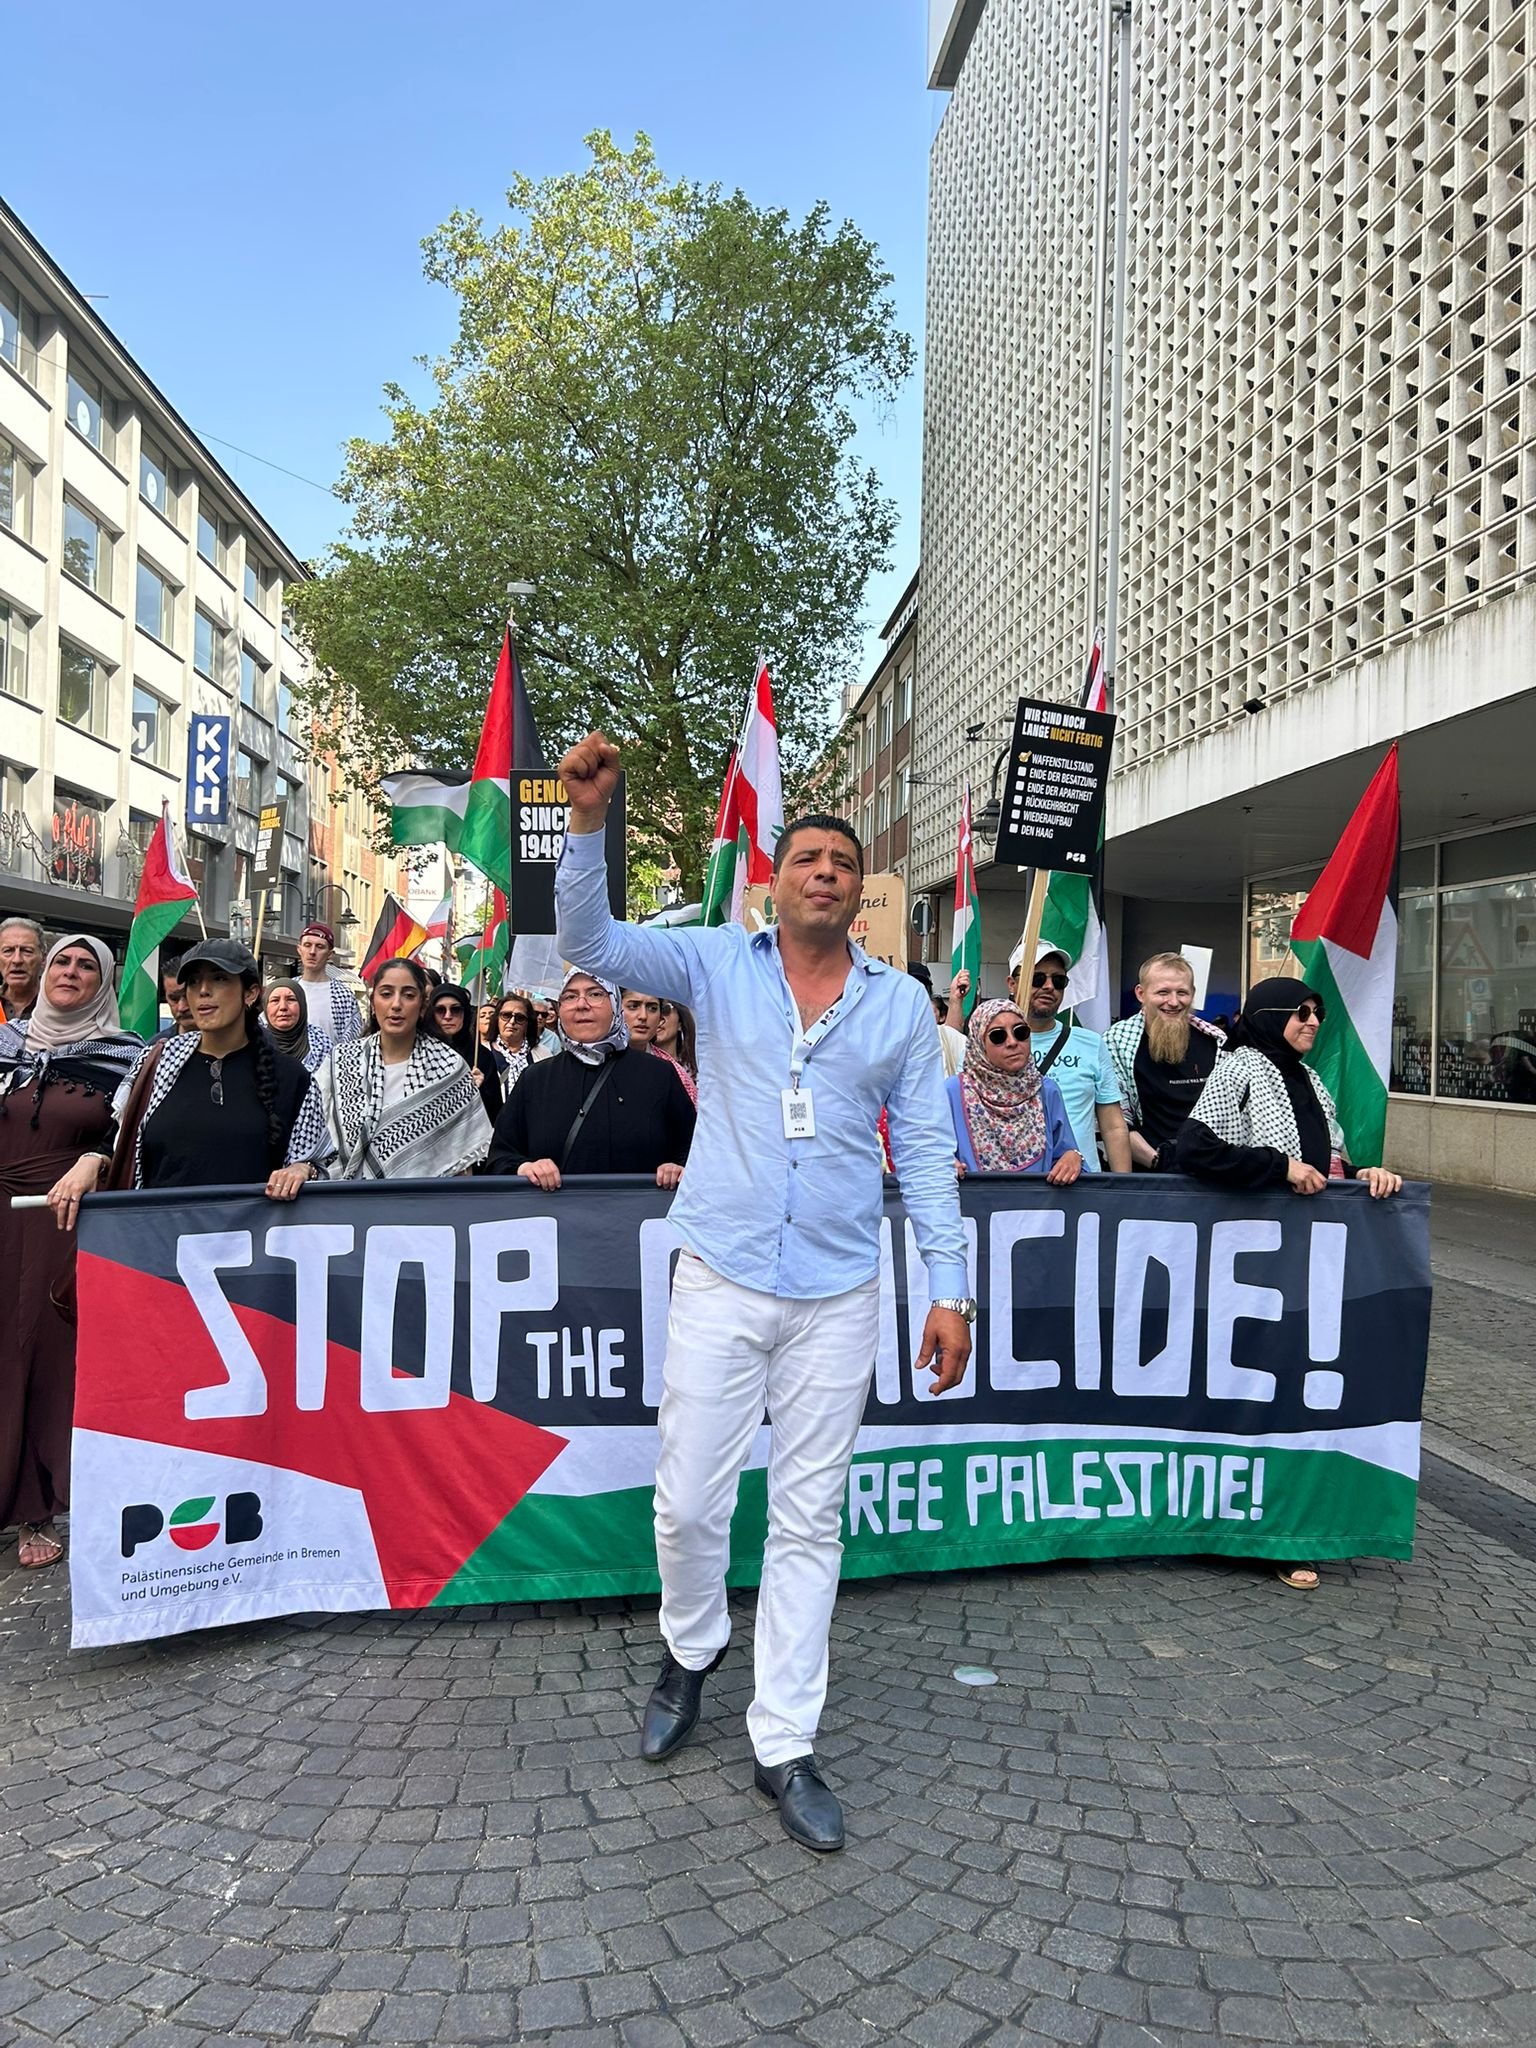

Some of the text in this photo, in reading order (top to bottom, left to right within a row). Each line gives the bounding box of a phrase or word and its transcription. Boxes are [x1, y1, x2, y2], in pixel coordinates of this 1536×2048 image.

[1024, 707, 1086, 730] WIR SIND NOCH
[1021, 722, 1103, 748] LANGE NICHT FERTIG
[194, 722, 222, 815] KKH
[1032, 753, 1094, 773] WAFFENSTILLSTAND
[1027, 782, 1045, 794] ENDE
[1045, 785, 1058, 796] DER
[1029, 768, 1097, 788] ENDE DER BESATZUNG
[520, 779, 570, 803] GENO
[1025, 794, 1080, 814] RÜCKKEHRRECHT
[1023, 810, 1073, 827] WIEDERAUFBAU
[1021, 825, 1054, 839] DEN HAAG
[520, 834, 564, 859] 1948
[176, 1216, 559, 1420] STOP
[525, 1326, 625, 1399] THE
[848, 1451, 1265, 1536] REE PALESTINE!
[121, 1547, 341, 1584] Palästinensische Gemeinde in Bremen
[121, 1573, 242, 1601] und Umgebung e.V.
